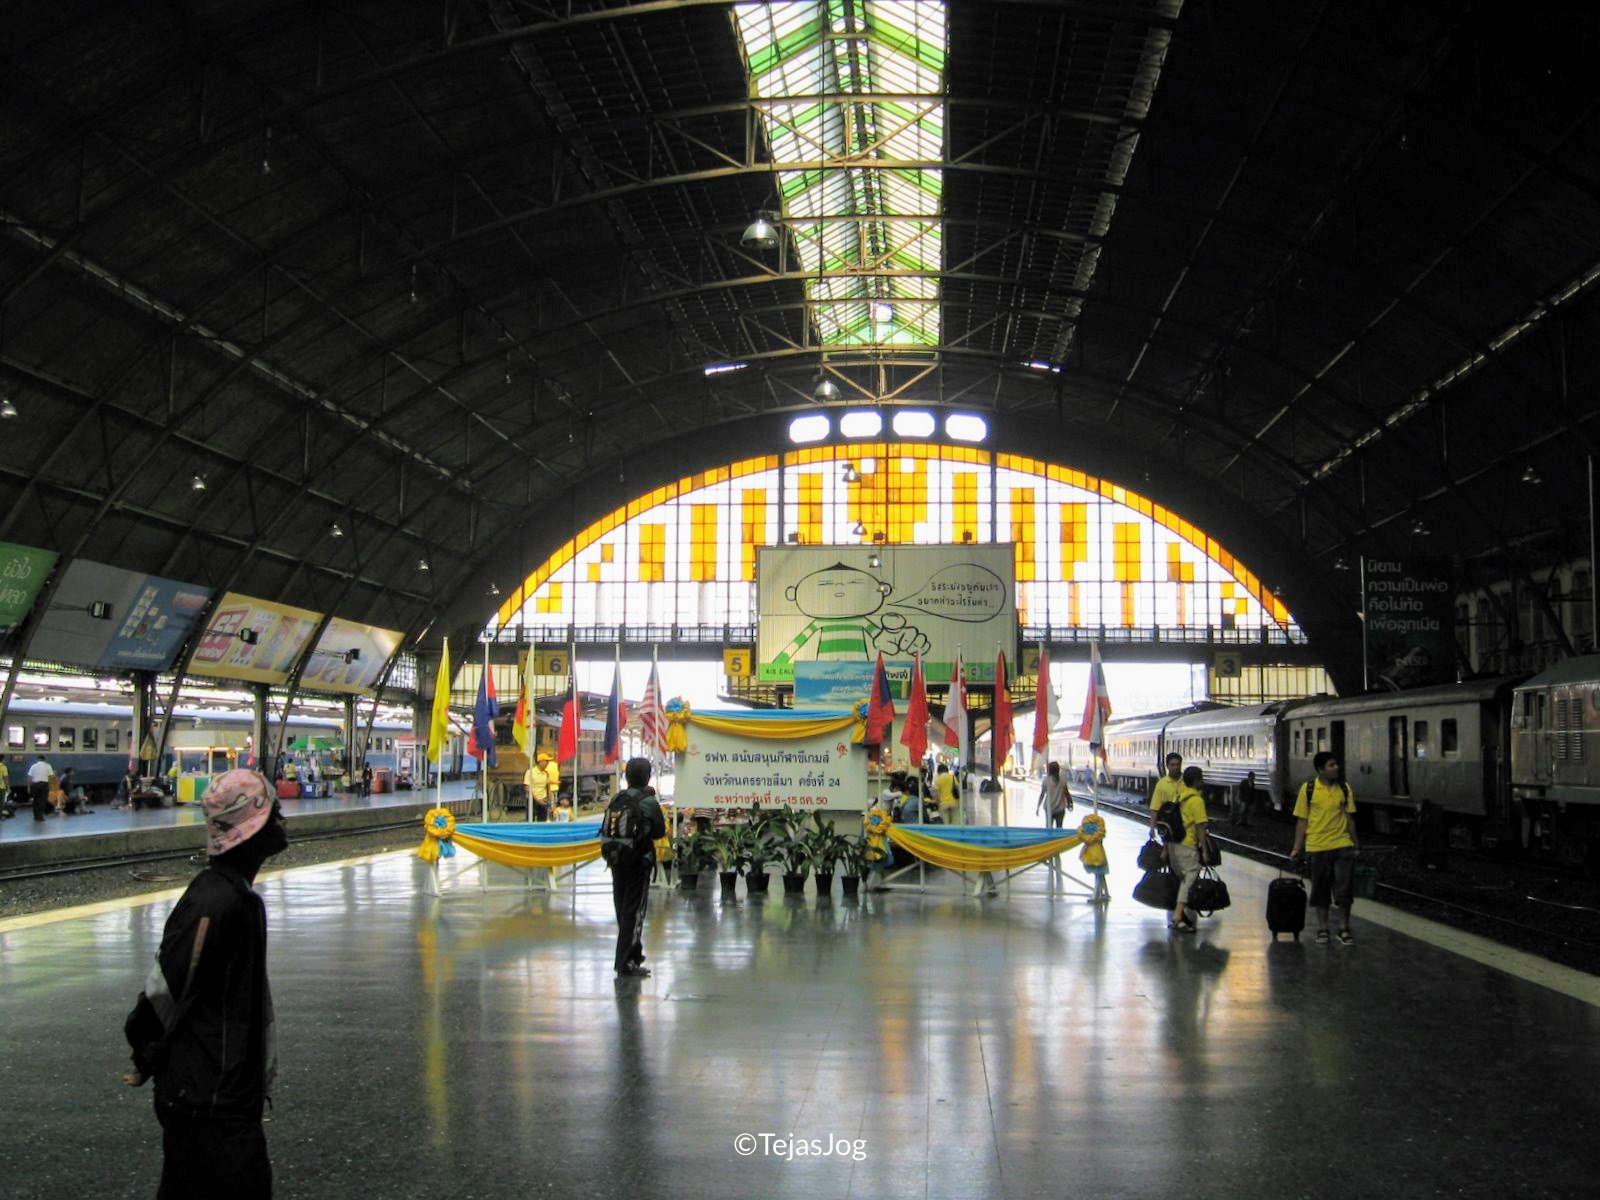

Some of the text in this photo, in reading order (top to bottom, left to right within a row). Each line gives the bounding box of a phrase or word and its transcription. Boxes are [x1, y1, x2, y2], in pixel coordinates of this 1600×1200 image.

[550, 657, 561, 673] 6
[731, 656, 742, 673] 5
[1030, 656, 1040, 672] 4
[1223, 658, 1235, 674] 3
[703, 771, 840, 788] จังหวัดนครราชสีมา ครั้งที่ 24
[714, 790, 771, 804] ระหว่างวันที่
[816, 796, 828, 805] 50
